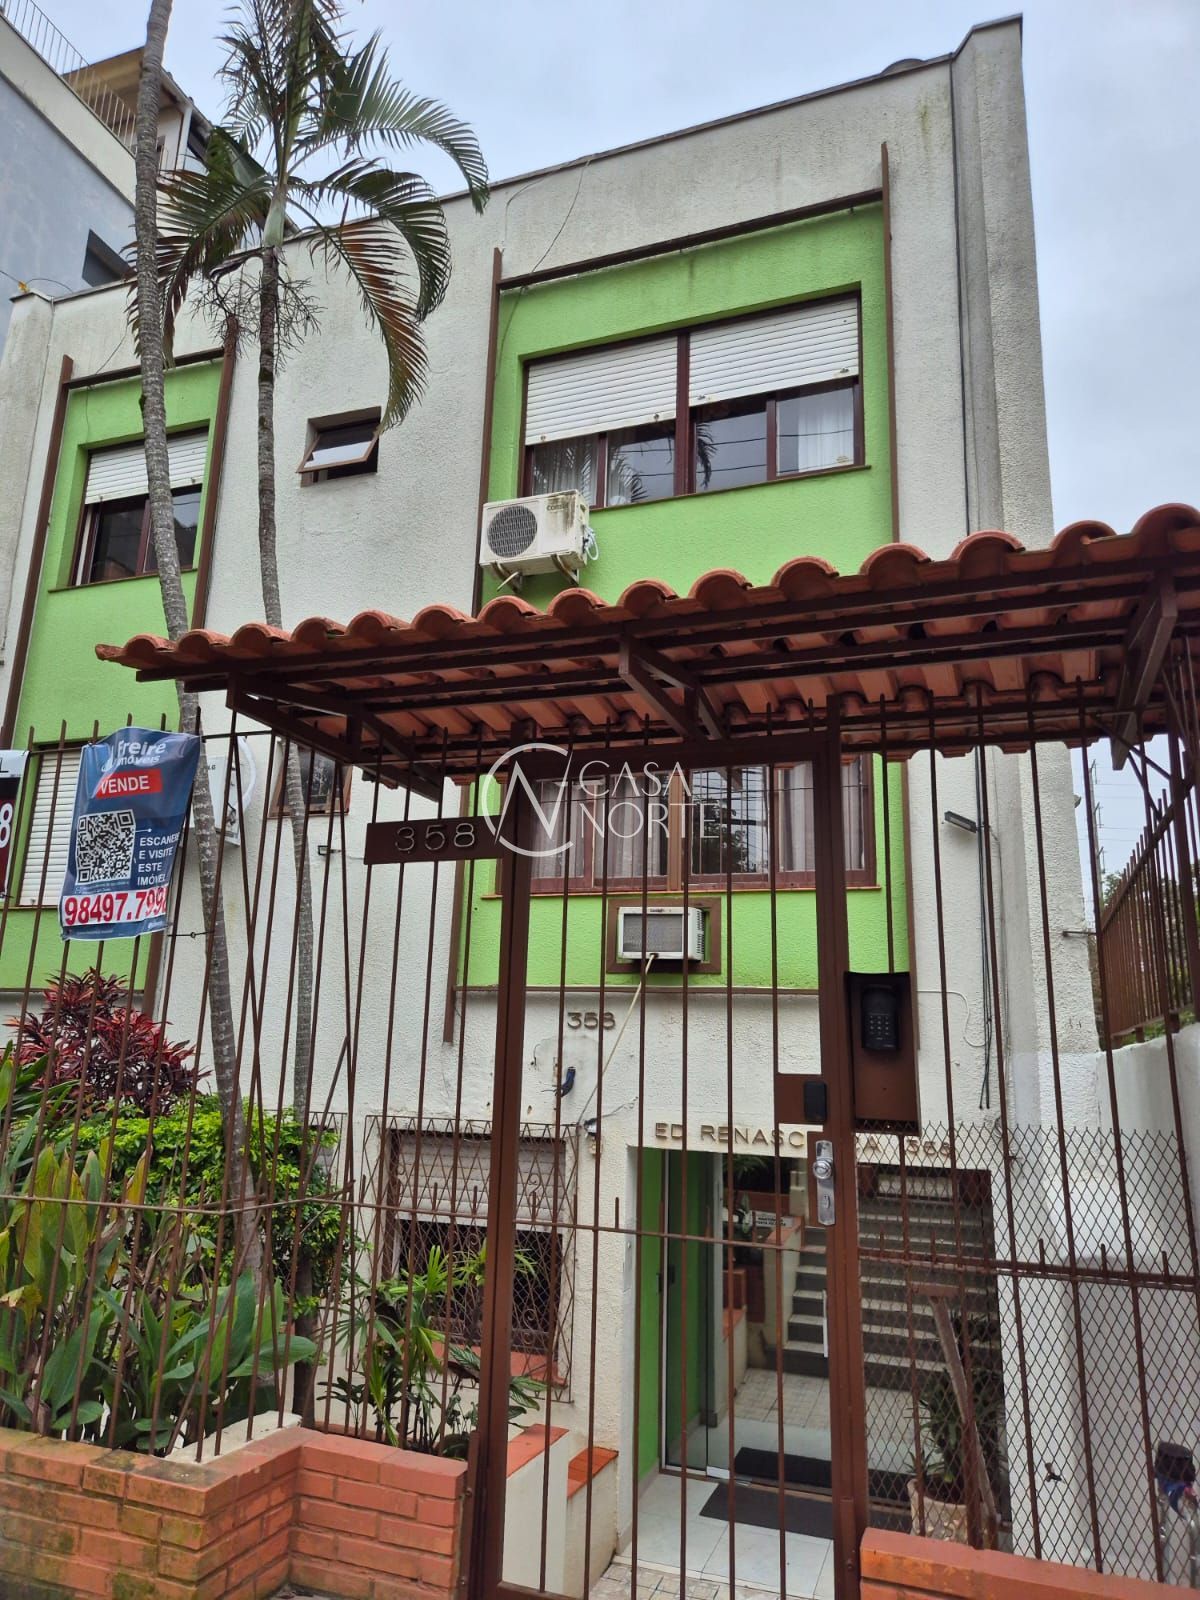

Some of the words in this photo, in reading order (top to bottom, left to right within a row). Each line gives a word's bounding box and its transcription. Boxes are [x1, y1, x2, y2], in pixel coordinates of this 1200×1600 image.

[117, 740, 166, 756] freire
[101, 775, 150, 795] VENDE
[394, 822, 476, 852] 358
[138, 850, 146, 860] E
[148, 846, 173, 860] VISITE
[137, 862, 163, 873] ESTE
[567, 1011, 616, 1031] 358
